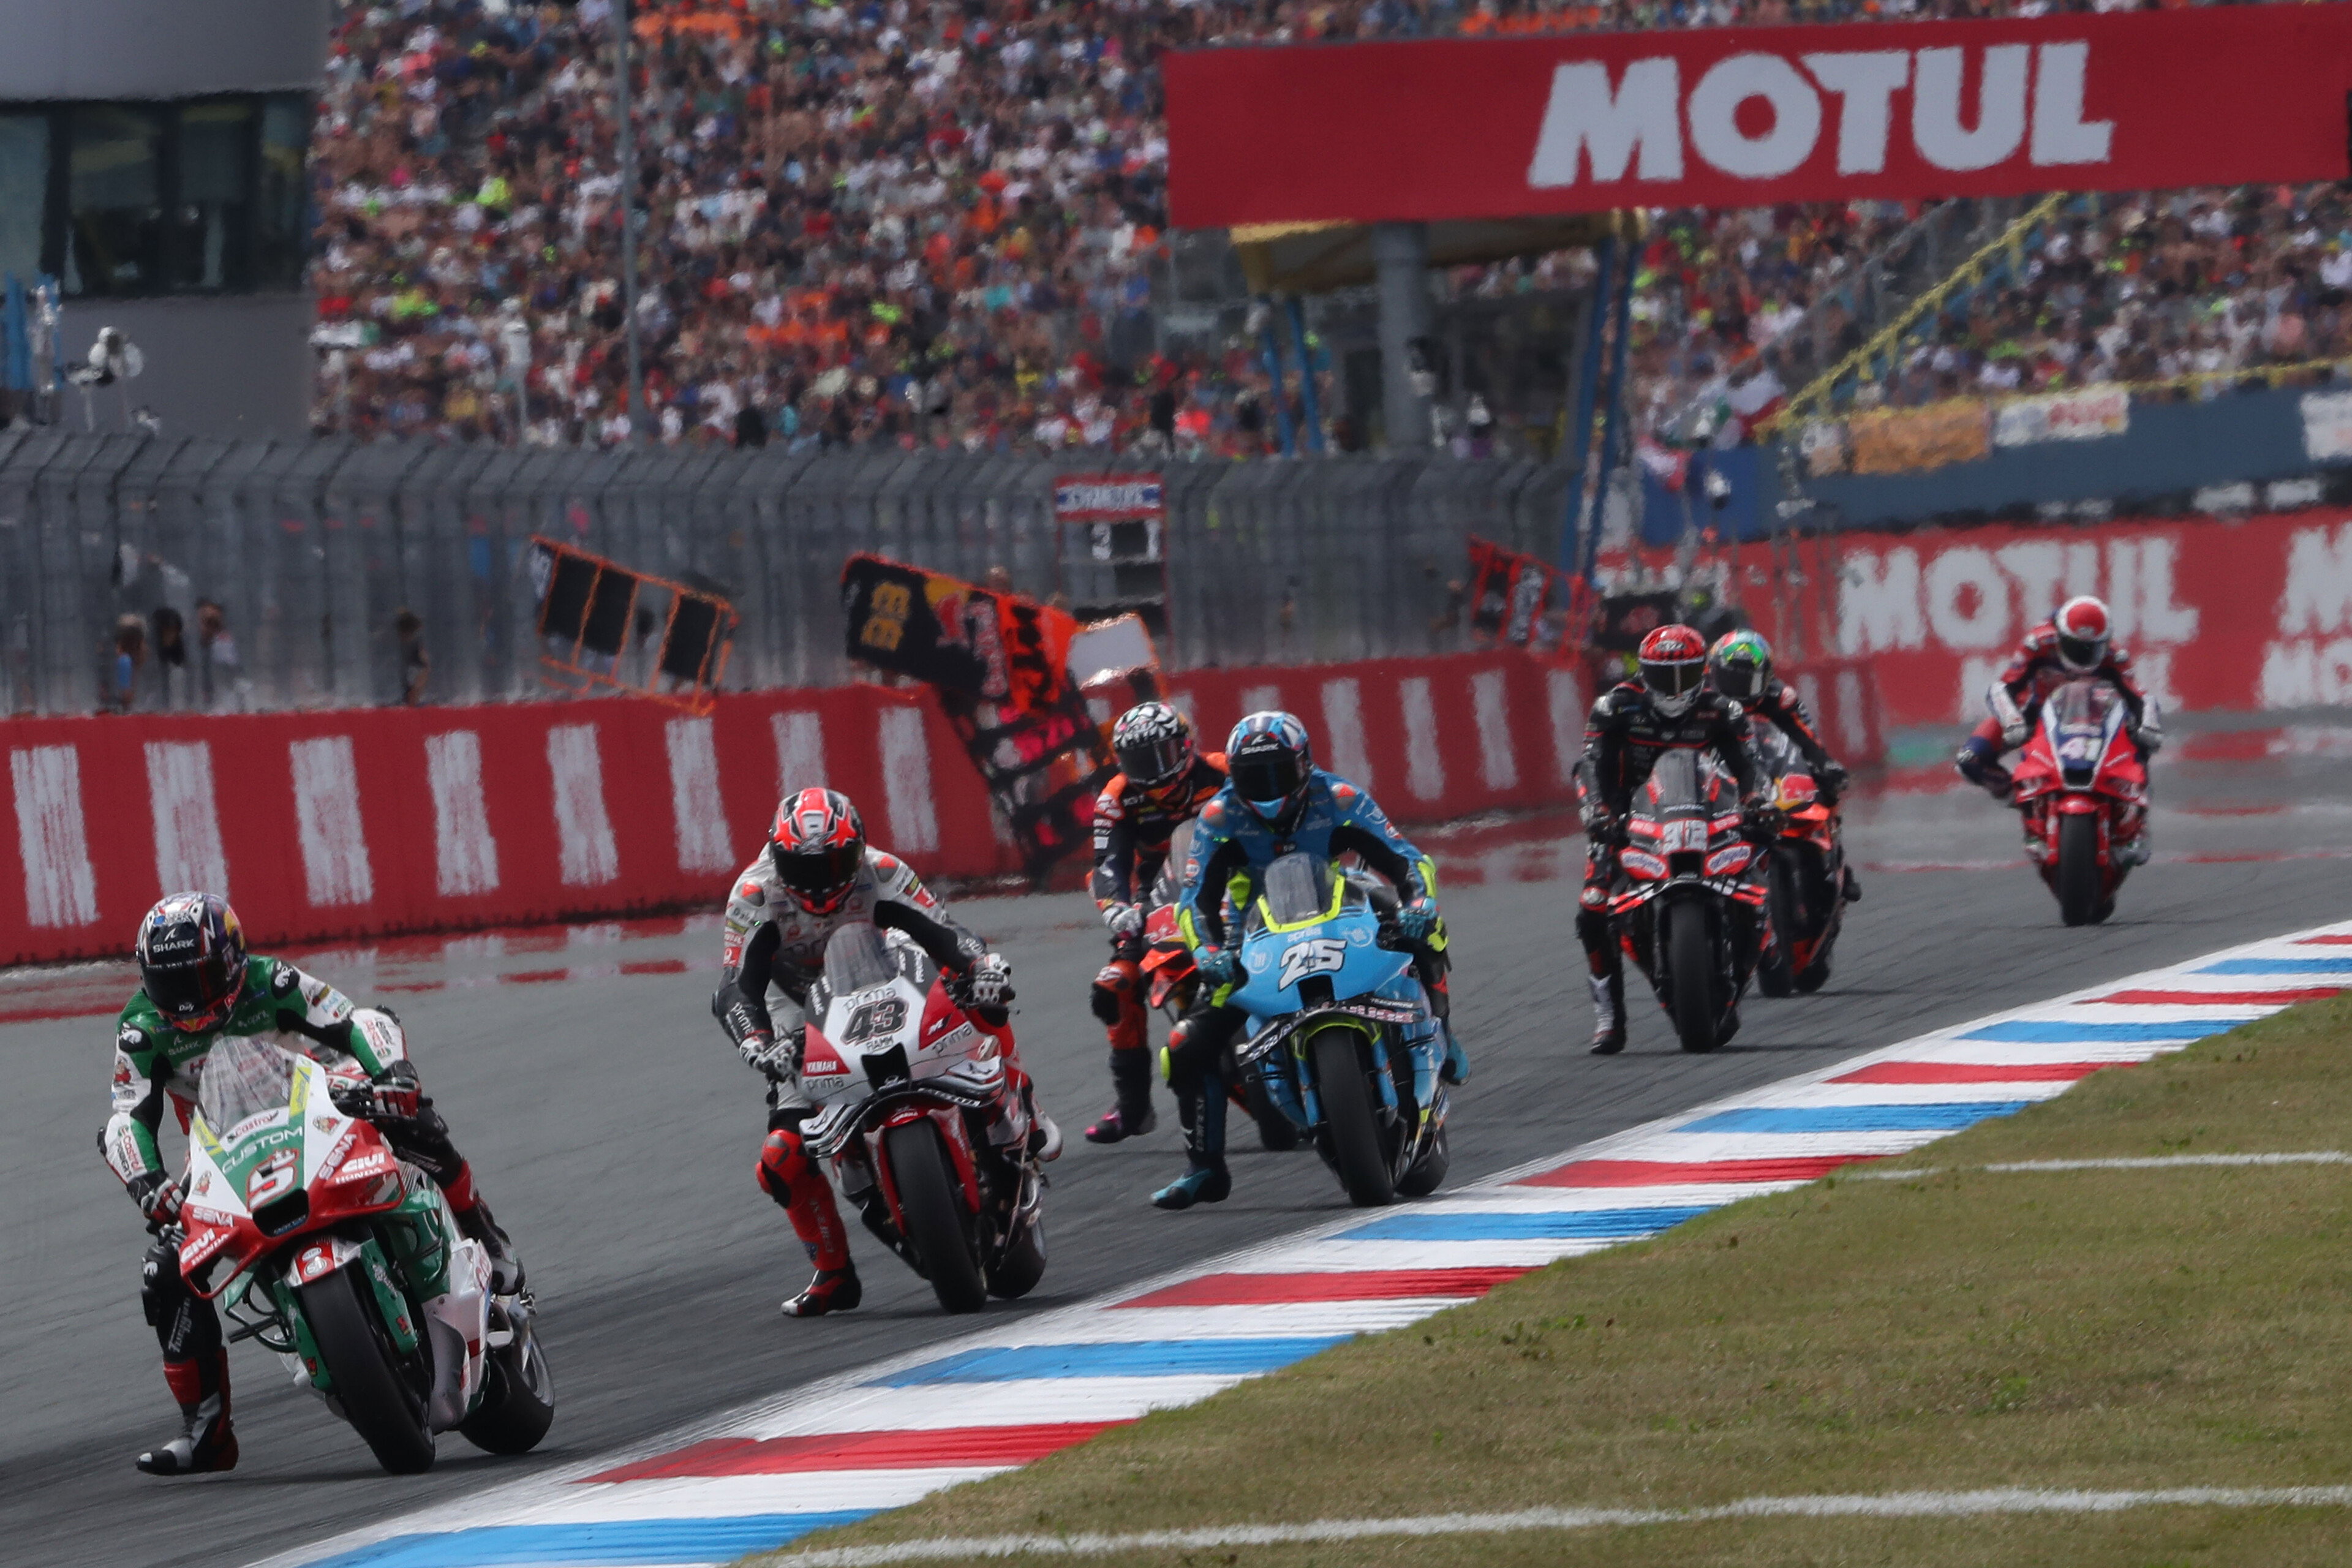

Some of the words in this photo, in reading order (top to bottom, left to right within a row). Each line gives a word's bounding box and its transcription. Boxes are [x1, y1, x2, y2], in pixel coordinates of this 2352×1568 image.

[1528, 40, 2115, 190] MOTUL
[1838, 534, 2199, 657] MOTUL
[153, 938, 195, 953] SHARK
[1278, 938, 1347, 992] 25
[843, 987, 896, 1013] prima
[730, 1001, 755, 1036] prima
[840, 997, 909, 1046] 43
[931, 1023, 973, 1058] prima
[806, 1060, 837, 1073] YAMAHA
[805, 1076, 845, 1093] prima
[234, 1109, 279, 1138] Castrol
[222, 1125, 303, 1175] CUSTOM
[318, 1133, 358, 1181] SENA
[341, 1152, 386, 1174] GIVI
[246, 1147, 300, 1213] 5
[334, 1166, 383, 1185] HONDA
[192, 1205, 234, 1228] SENA
